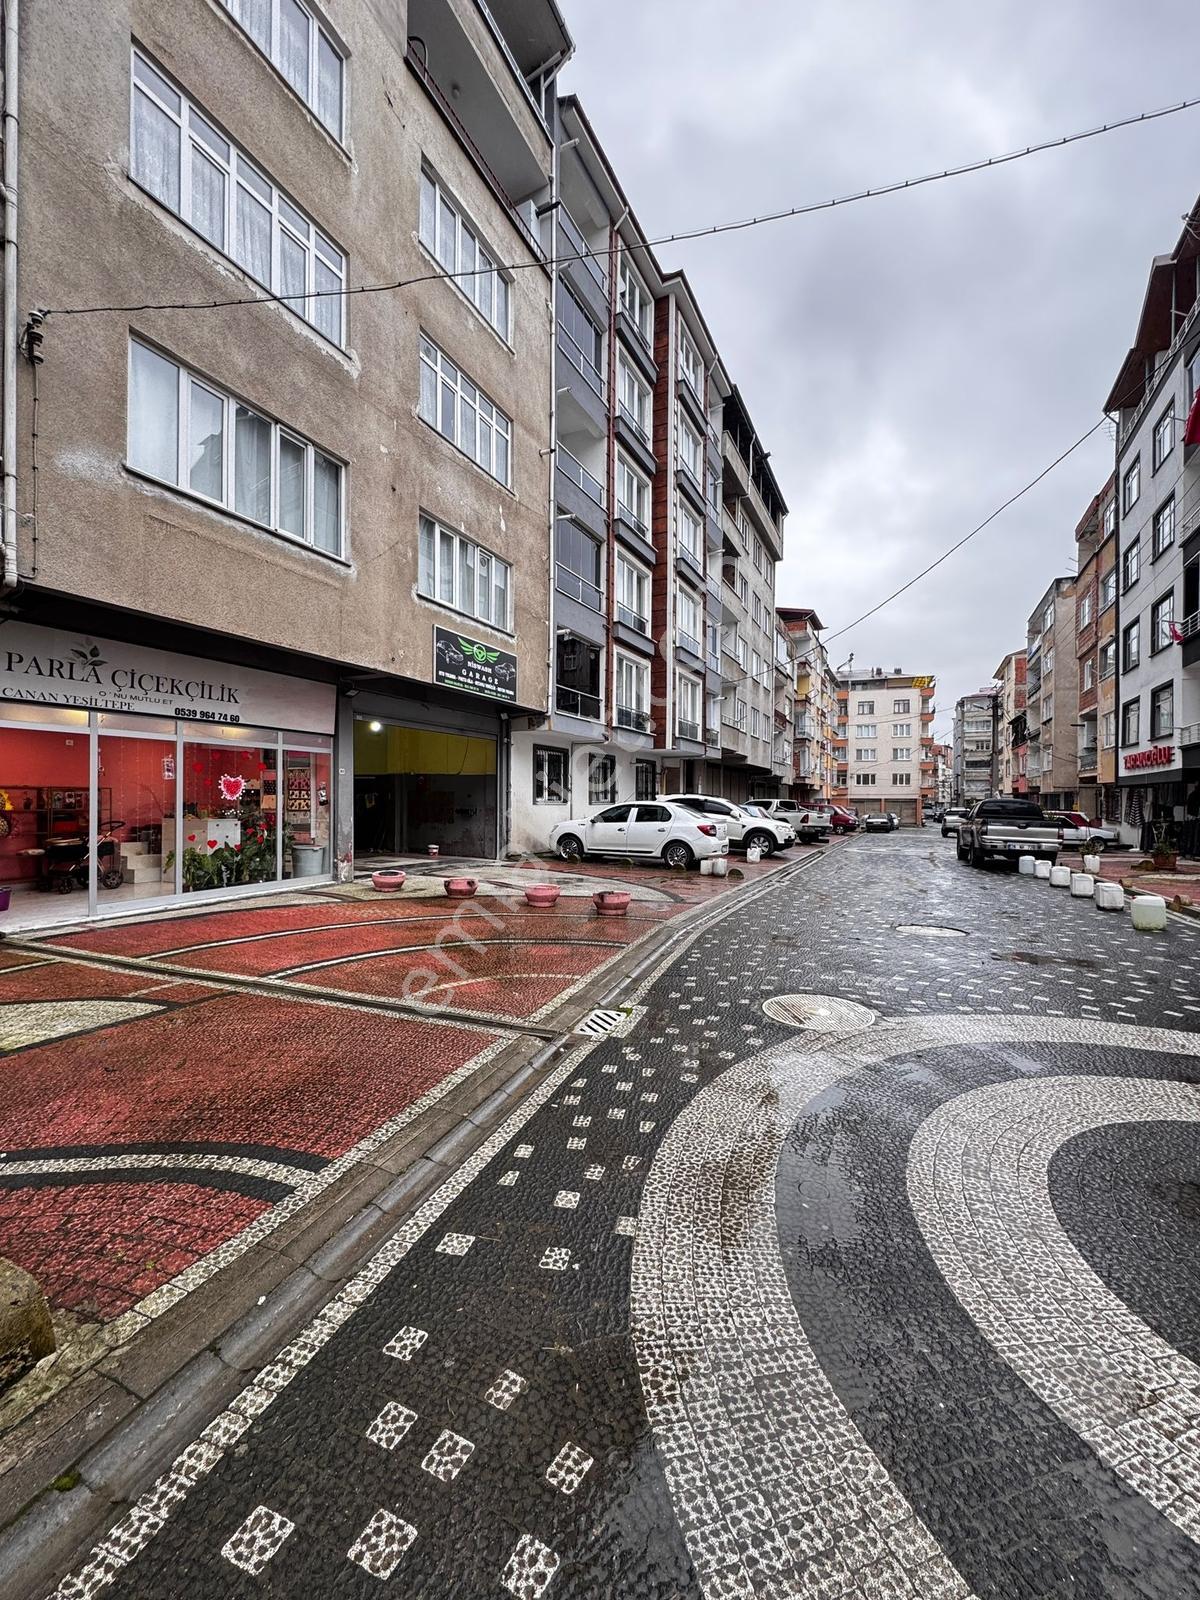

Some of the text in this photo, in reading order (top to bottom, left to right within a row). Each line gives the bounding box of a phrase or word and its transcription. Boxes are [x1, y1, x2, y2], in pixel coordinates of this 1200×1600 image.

[6, 651, 240, 704] PARLA ÇİÇEKÇİLİK
[462, 669, 499, 684] GARAGE
[2, 687, 60, 703] CANAN
[129, 694, 160, 704] MUTLU
[161, 698, 174, 706] ET
[174, 707, 241, 723] 0539 964 74 60
